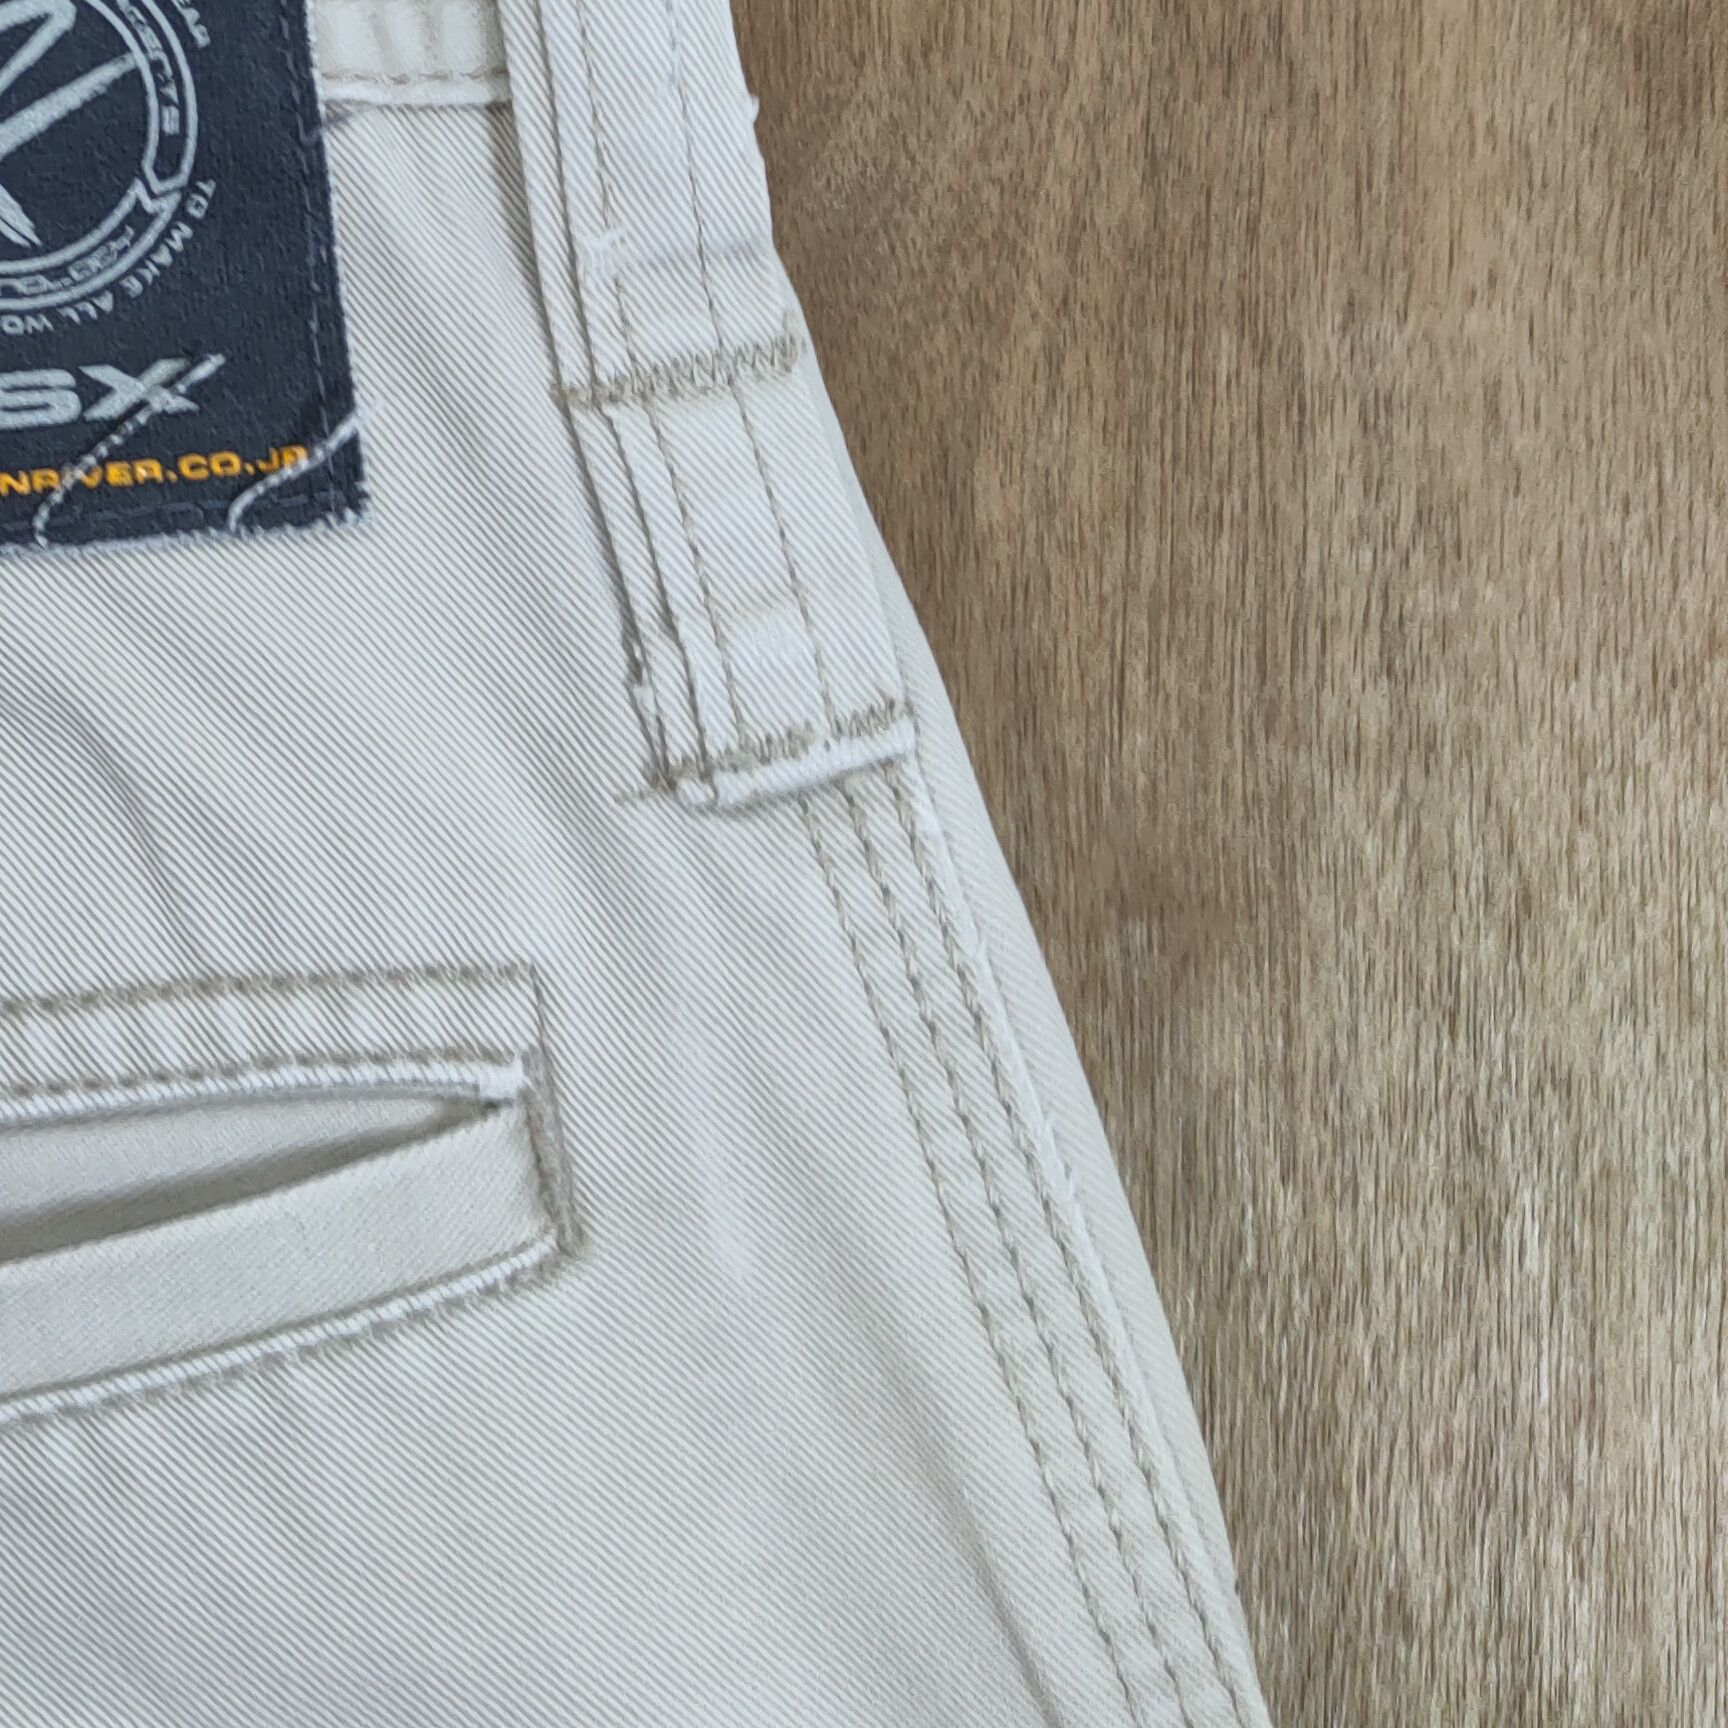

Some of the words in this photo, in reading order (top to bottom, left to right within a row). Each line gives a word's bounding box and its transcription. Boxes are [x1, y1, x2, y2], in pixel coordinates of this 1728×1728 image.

[185, 178, 217, 220] TO
[121, 221, 194, 298] MAKE
[56, 290, 114, 325] ALL
